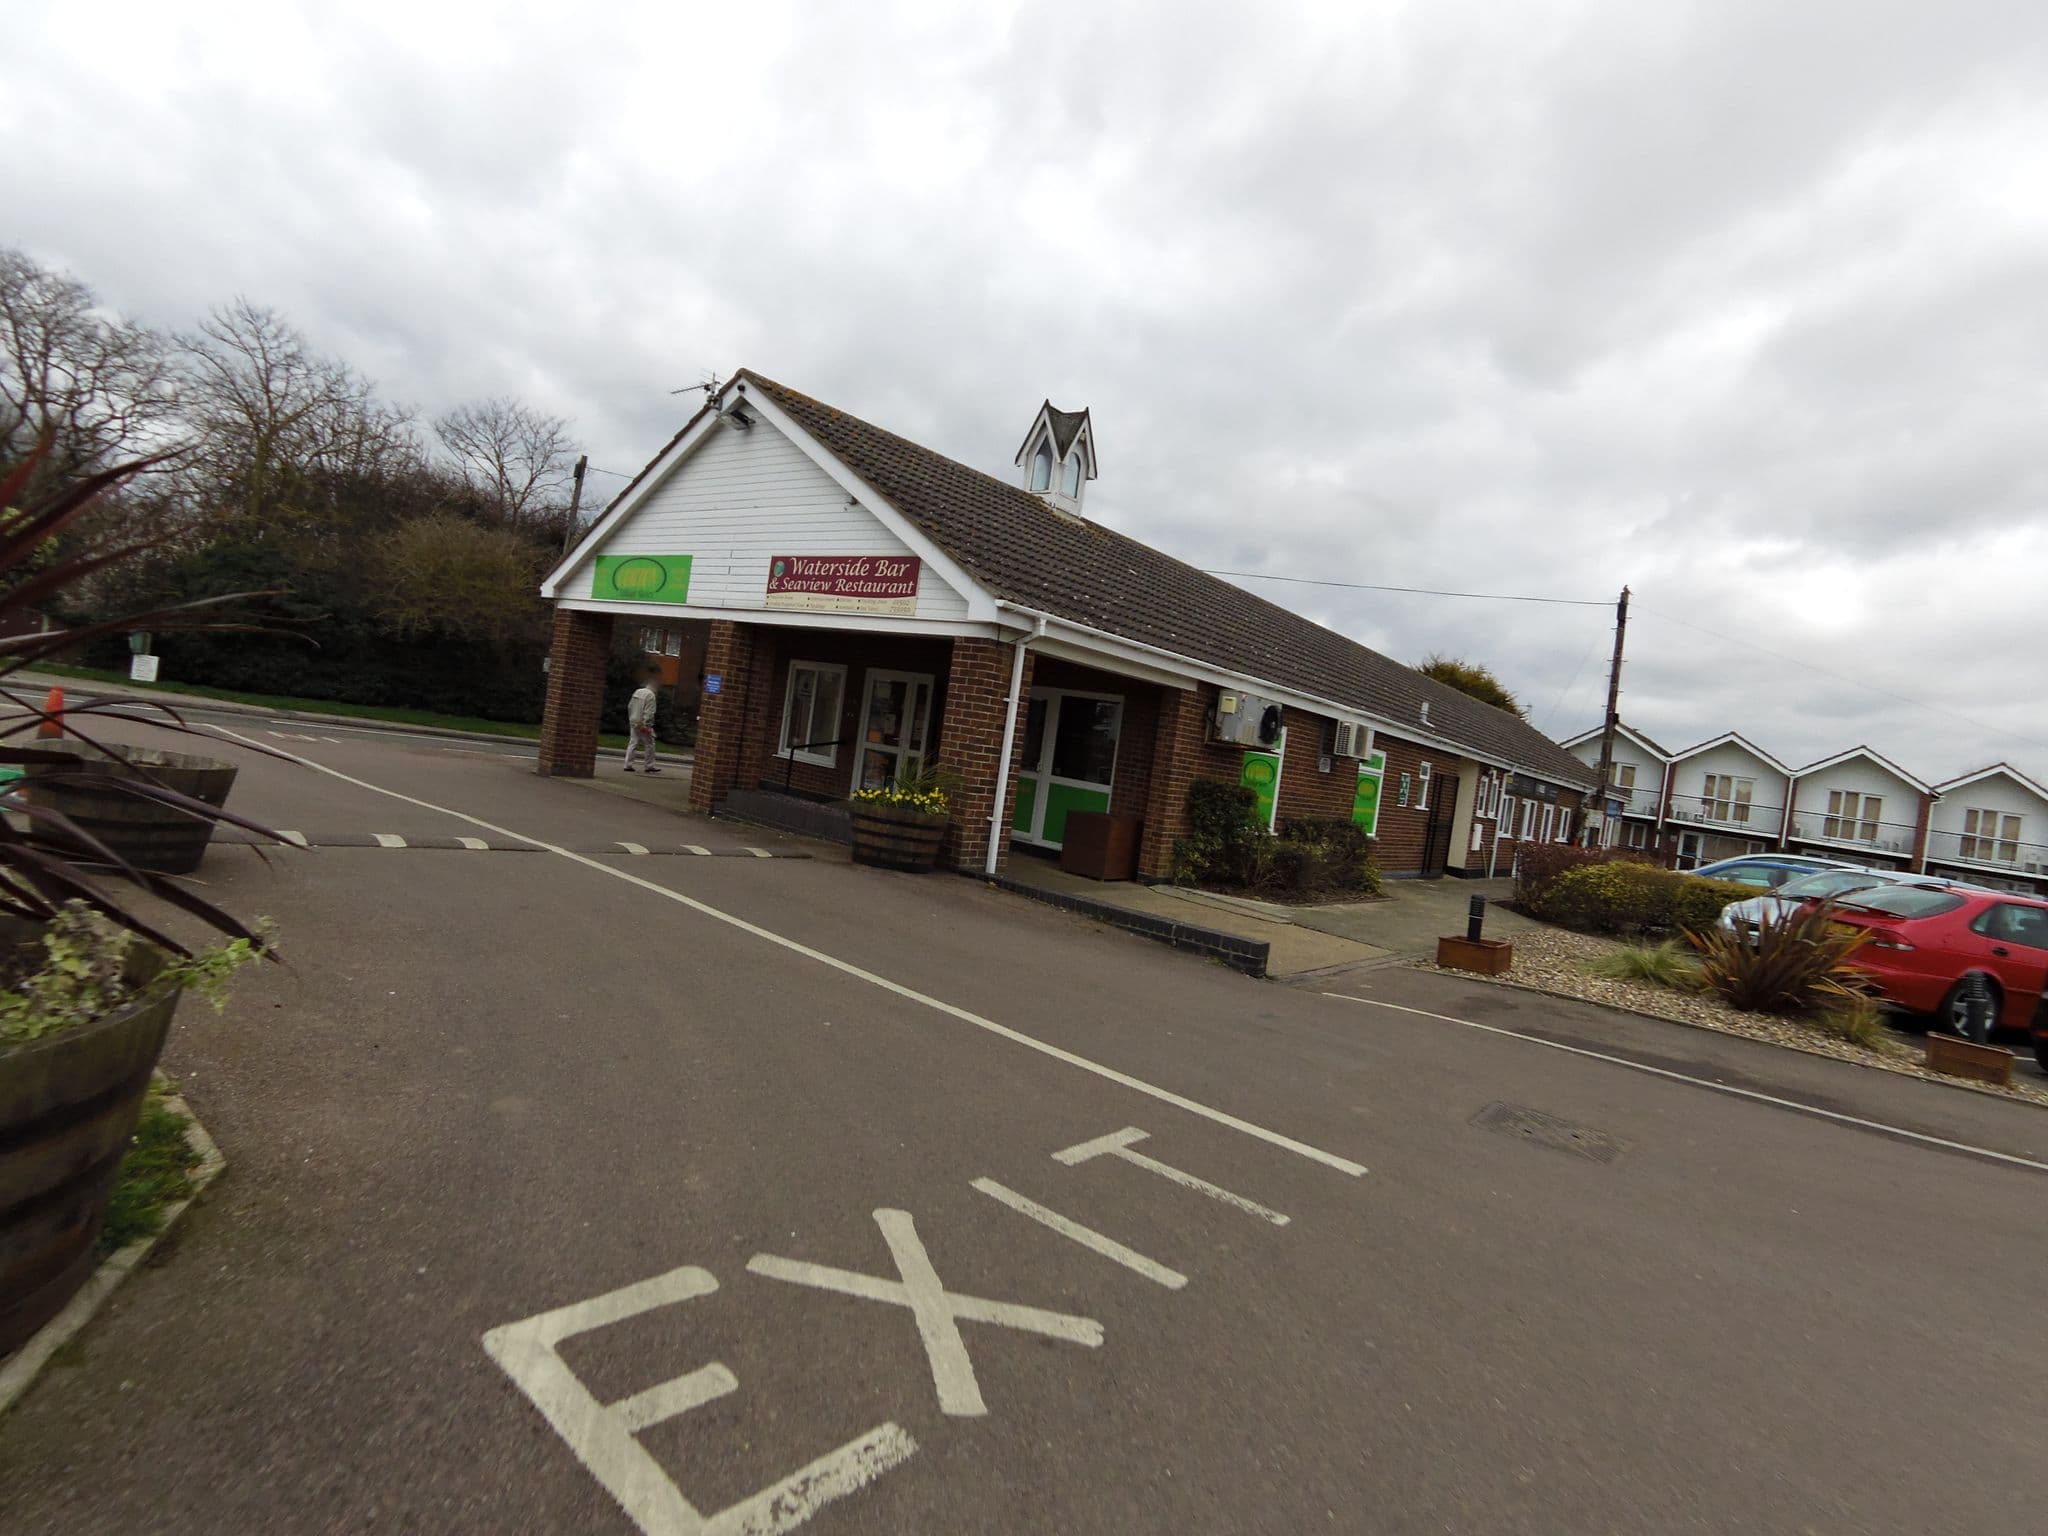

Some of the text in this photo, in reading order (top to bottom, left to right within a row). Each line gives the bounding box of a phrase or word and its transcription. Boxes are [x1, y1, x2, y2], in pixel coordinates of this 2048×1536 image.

[791, 556, 911, 577] Waterside Bar
[769, 576, 915, 594] & Seaview Restaurant
[481, 1126, 1291, 1536] EXIT
